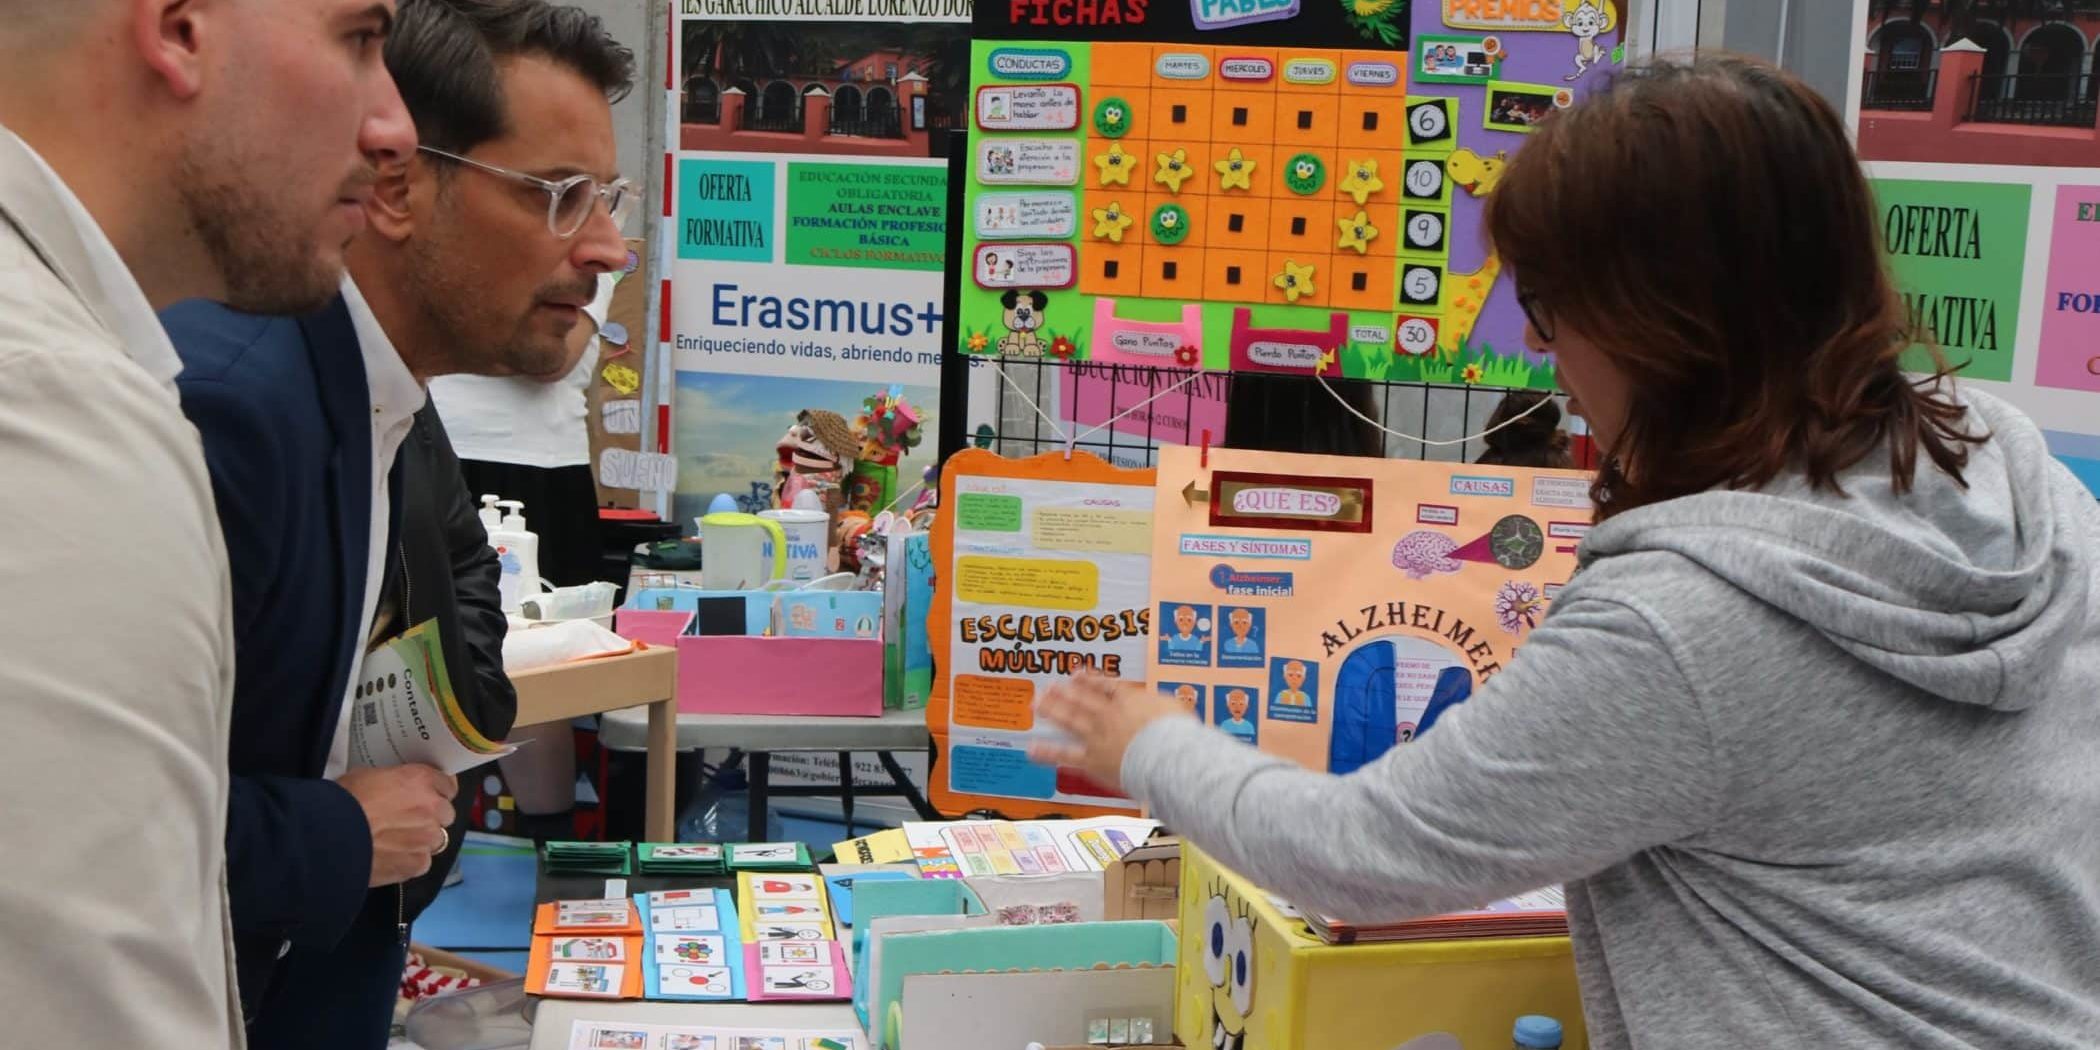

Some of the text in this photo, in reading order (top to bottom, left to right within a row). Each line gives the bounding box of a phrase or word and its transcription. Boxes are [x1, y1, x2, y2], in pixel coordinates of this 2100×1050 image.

[1010, 0, 1148, 25] FICHAS
[1449, 0, 1561, 22] PREMIOS
[996, 54, 1061, 70] CONDUCTAS
[1165, 61, 1200, 71] MARTES
[1293, 66, 1325, 76] JUEVES
[1353, 69, 1392, 80] VIERNES
[1419, 110, 1435, 131] 6
[699, 173, 752, 202] OFERTA
[1412, 169, 1433, 188] 10
[837, 187, 933, 202] OBLIGATORIA
[828, 203, 941, 217] AULAS ENCLAVE
[793, 215, 878, 230] FORMACIÓN
[1417, 218, 1430, 240] 9
[1885, 203, 1982, 260] OFERTA
[686, 217, 764, 248] FORMATIVA
[859, 234, 910, 247] BÁSICA
[810, 247, 861, 260] CICLOS
[1413, 275, 1430, 295] 5
[711, 283, 944, 336] Erasmus+
[1903, 292, 1998, 351] MATIVA
[1115, 335, 1175, 349] Gano Puntos
[1355, 326, 1427, 343] TOTAL 30
[676, 333, 786, 357] Enriqueciendo
[790, 340, 836, 361] vidas,
[841, 344, 913, 364] abriendo
[1254, 346, 1316, 361] Pierdo Puntos
[1454, 481, 1509, 493] CAUSAS
[1083, 498, 1121, 508] CAUSAS
[1299, 492, 1339, 513] ES?
[762, 541, 818, 559] NTIVA
[1183, 539, 1226, 552] FASES
[1230, 540, 1240, 552] Y
[1228, 584, 1292, 597] fase inicial
[960, 608, 1150, 643] ESCLEROSIS
[980, 641, 1121, 677] MÚLTIPLE
[404, 667, 430, 741] Contacto
